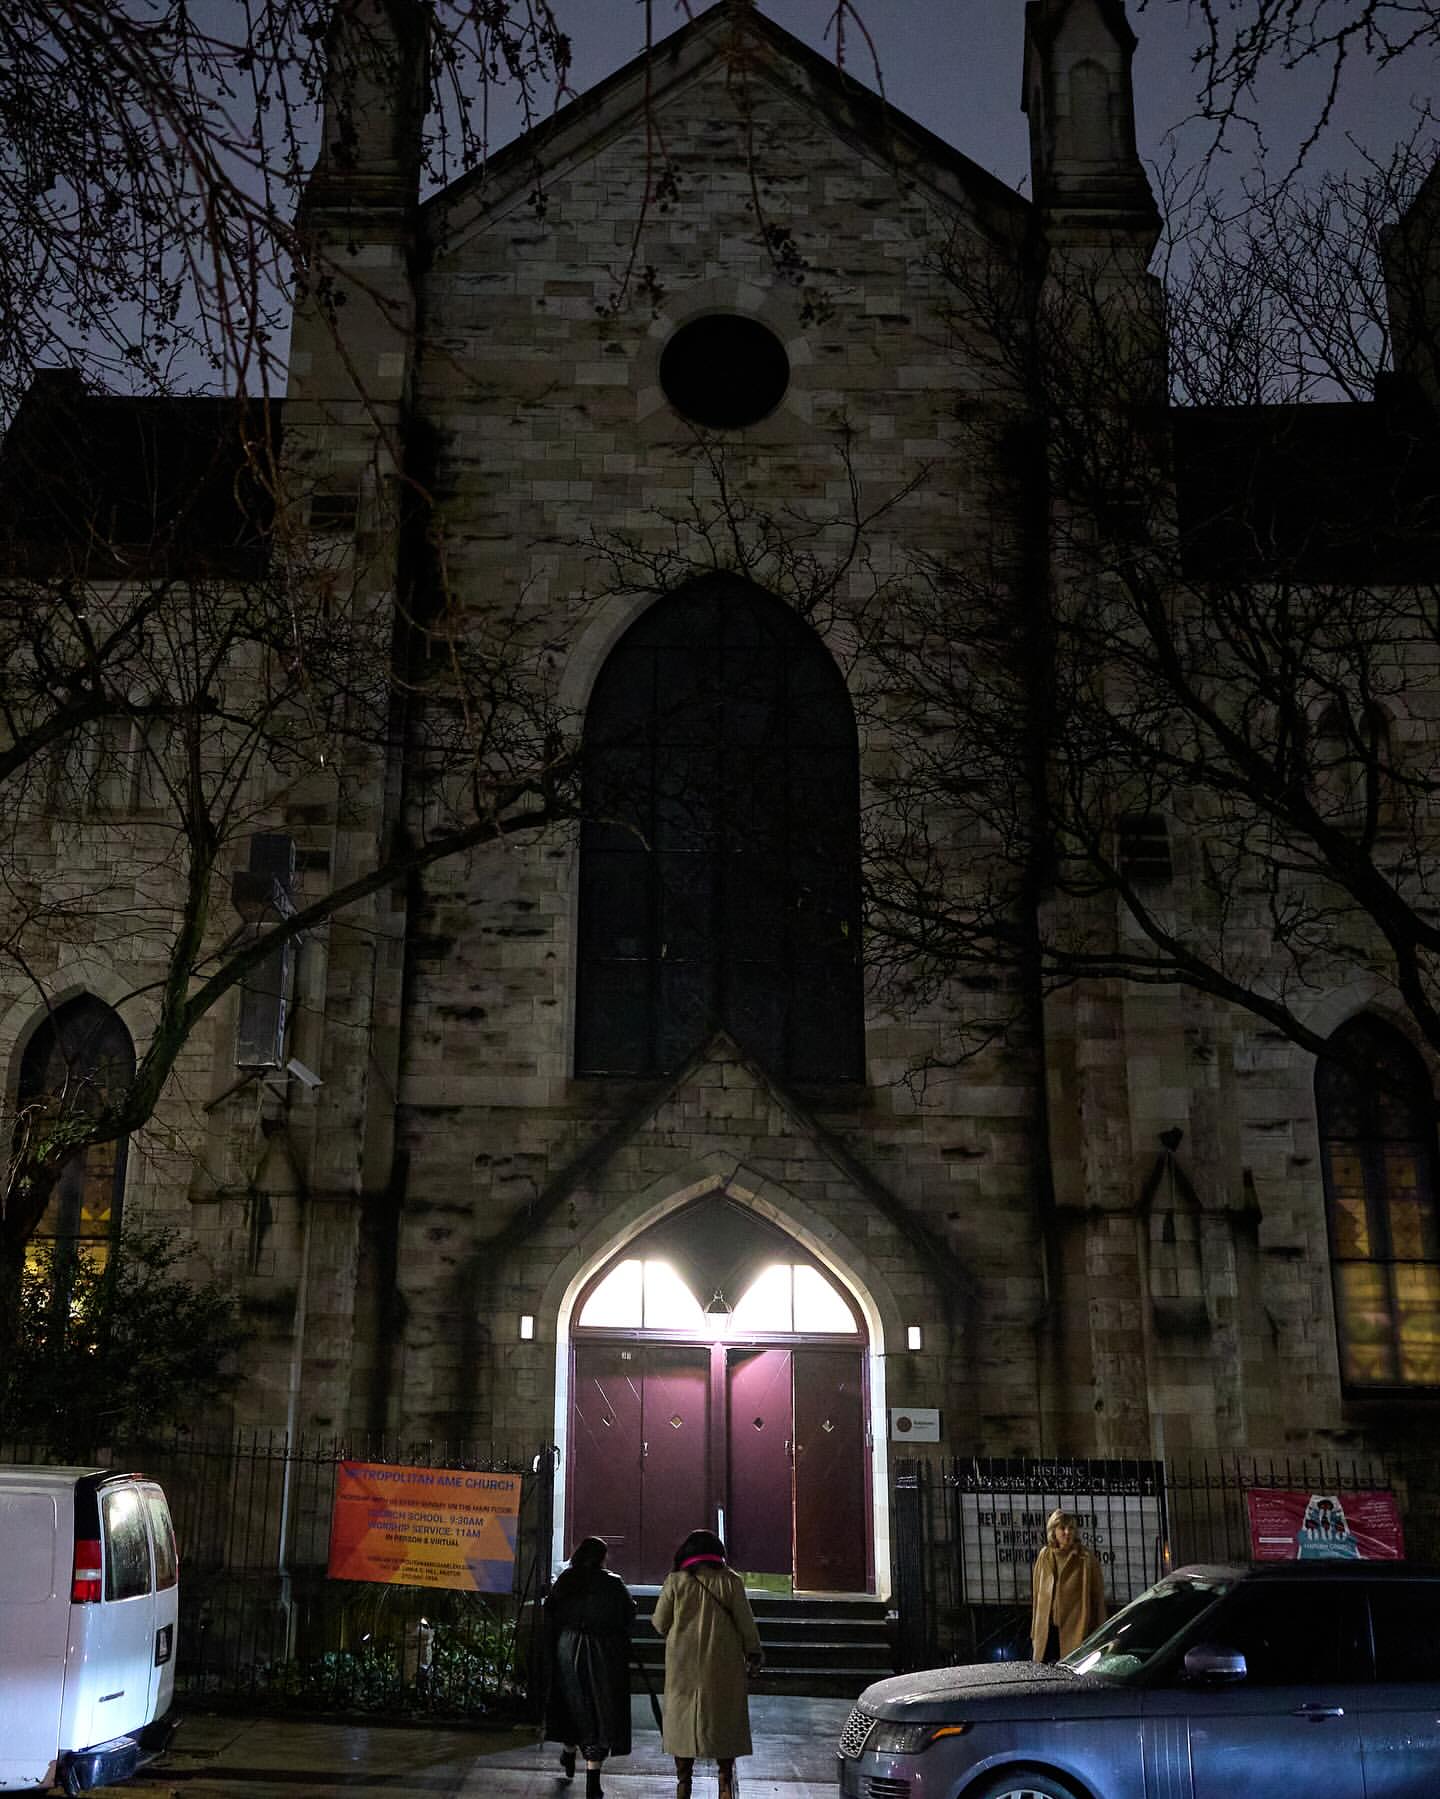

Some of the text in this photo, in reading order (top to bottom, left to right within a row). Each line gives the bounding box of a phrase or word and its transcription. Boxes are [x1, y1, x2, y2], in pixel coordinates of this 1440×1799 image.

[345, 1467, 515, 1491] METROPOLITAN AME CHURCH
[430, 1538, 459, 1547] VIRTUAL
